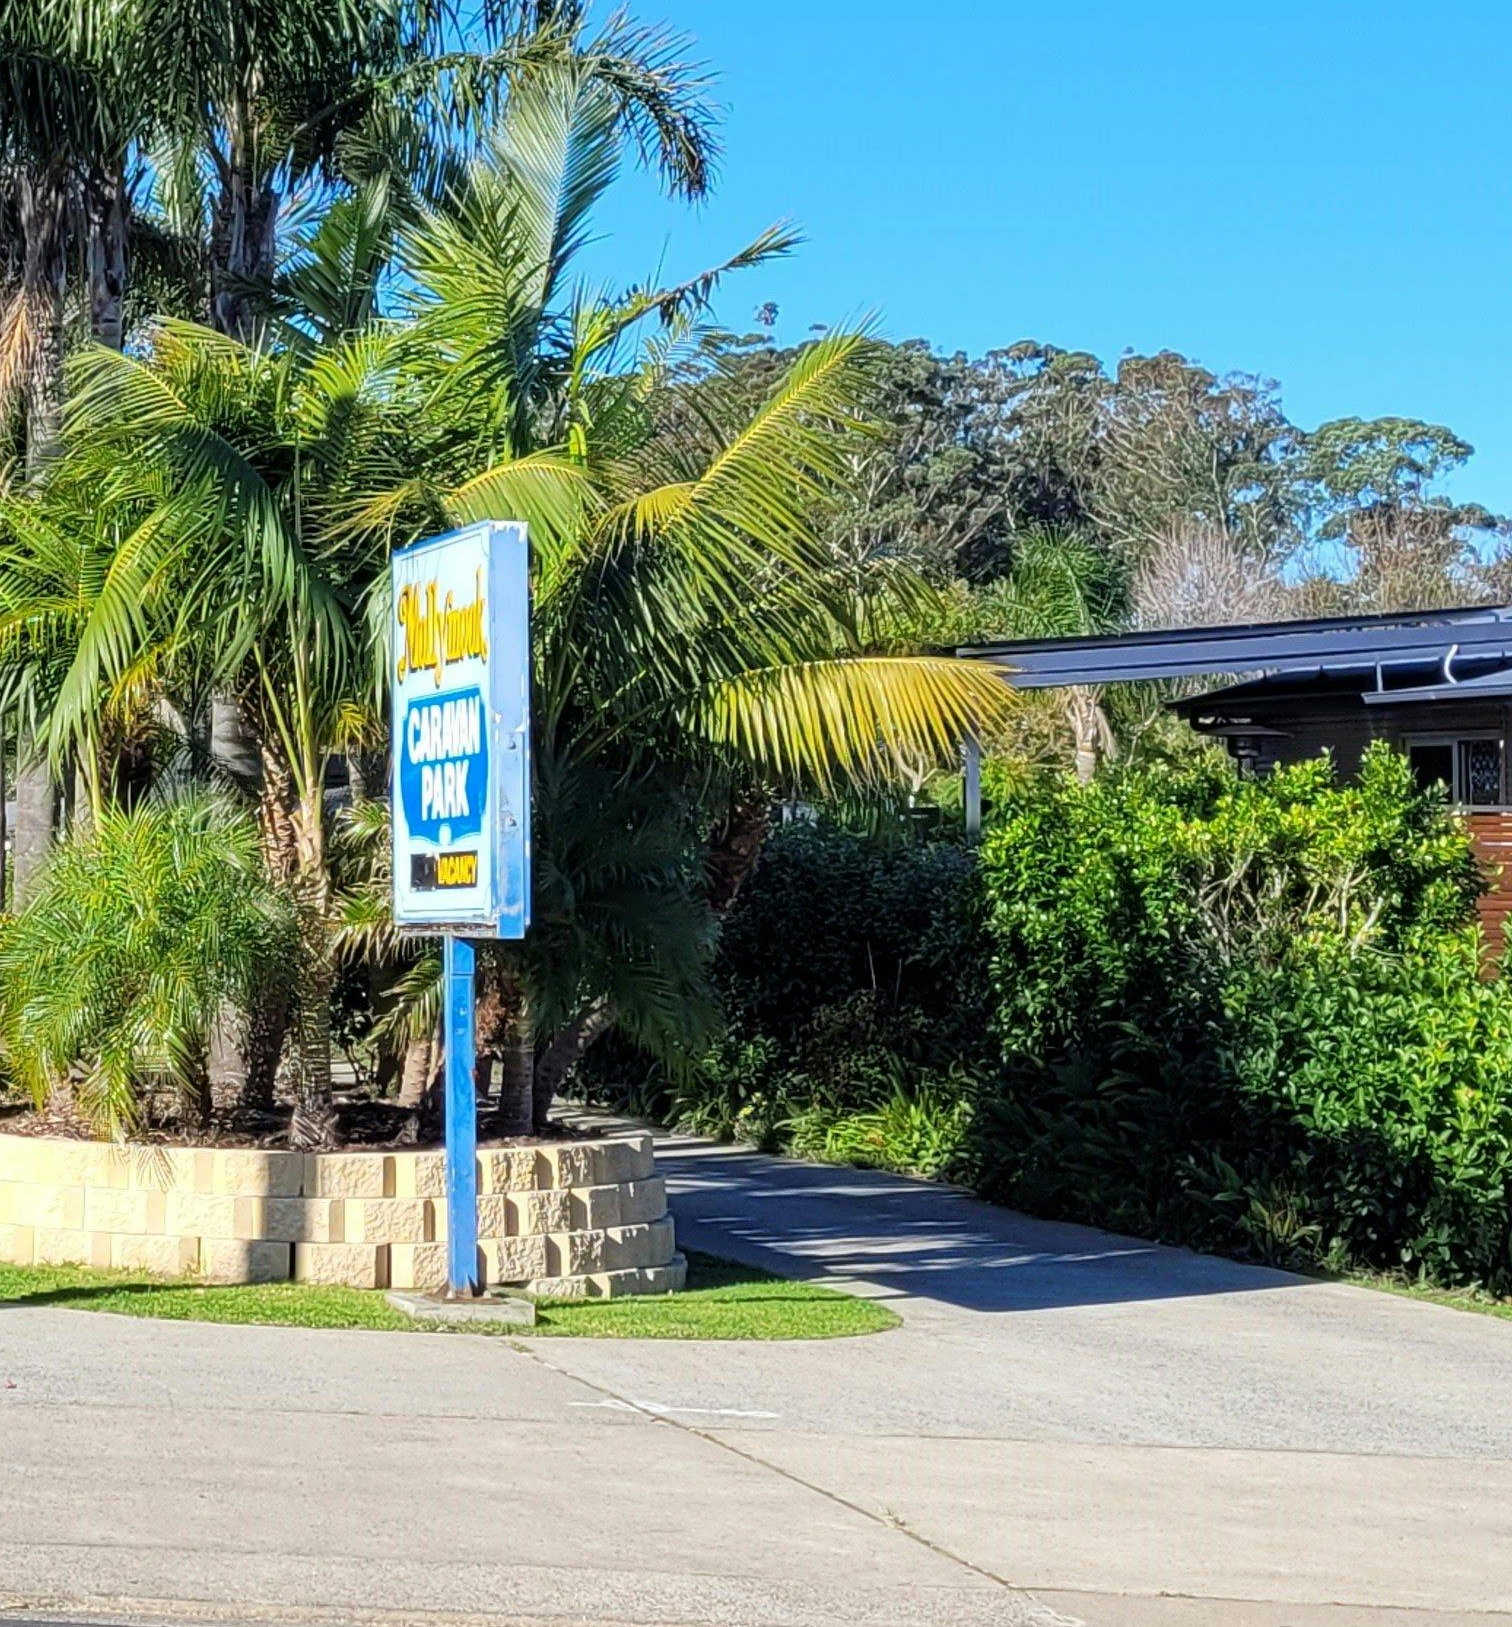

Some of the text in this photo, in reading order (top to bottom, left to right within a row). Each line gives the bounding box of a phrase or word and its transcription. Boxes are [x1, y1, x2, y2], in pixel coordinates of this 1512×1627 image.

[407, 695, 481, 765] CARAVAN
[421, 759, 470, 821] PARK
[438, 854, 477, 885] VACANCY
